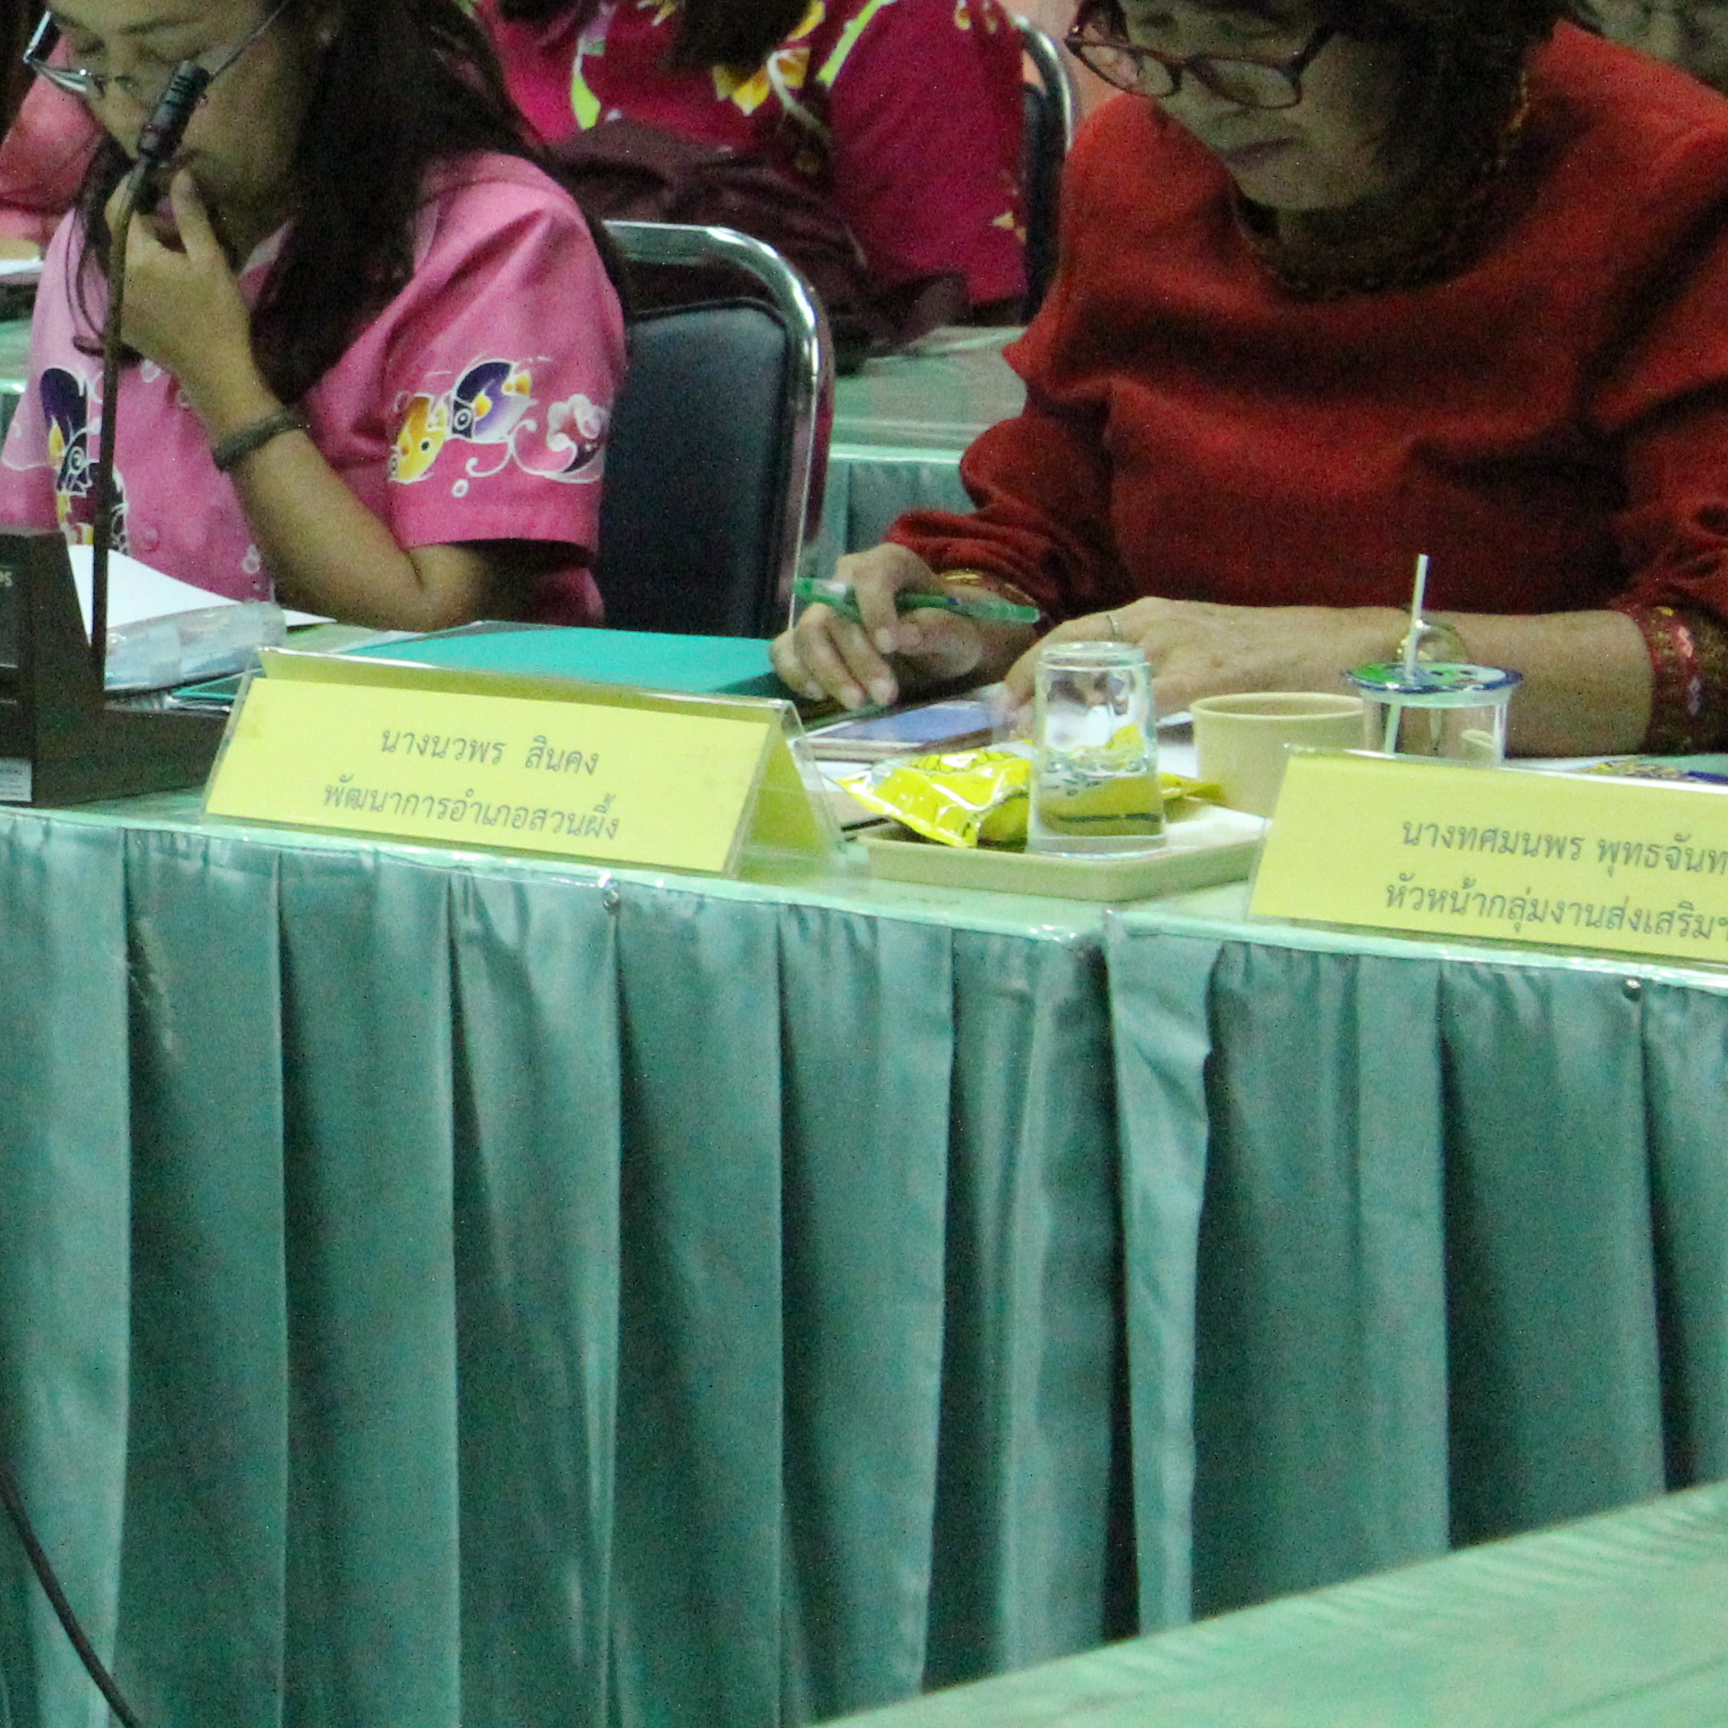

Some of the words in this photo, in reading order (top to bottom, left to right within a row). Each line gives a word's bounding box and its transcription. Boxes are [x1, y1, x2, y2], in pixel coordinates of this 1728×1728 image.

[381, 728, 507, 766] นางนวพร
[524, 734, 600, 776] สินคง
[323, 774, 620, 841] พัฒนาการอำเภอสวนผึ้ง
[1402, 821, 1585, 861] นางทศมนพร
